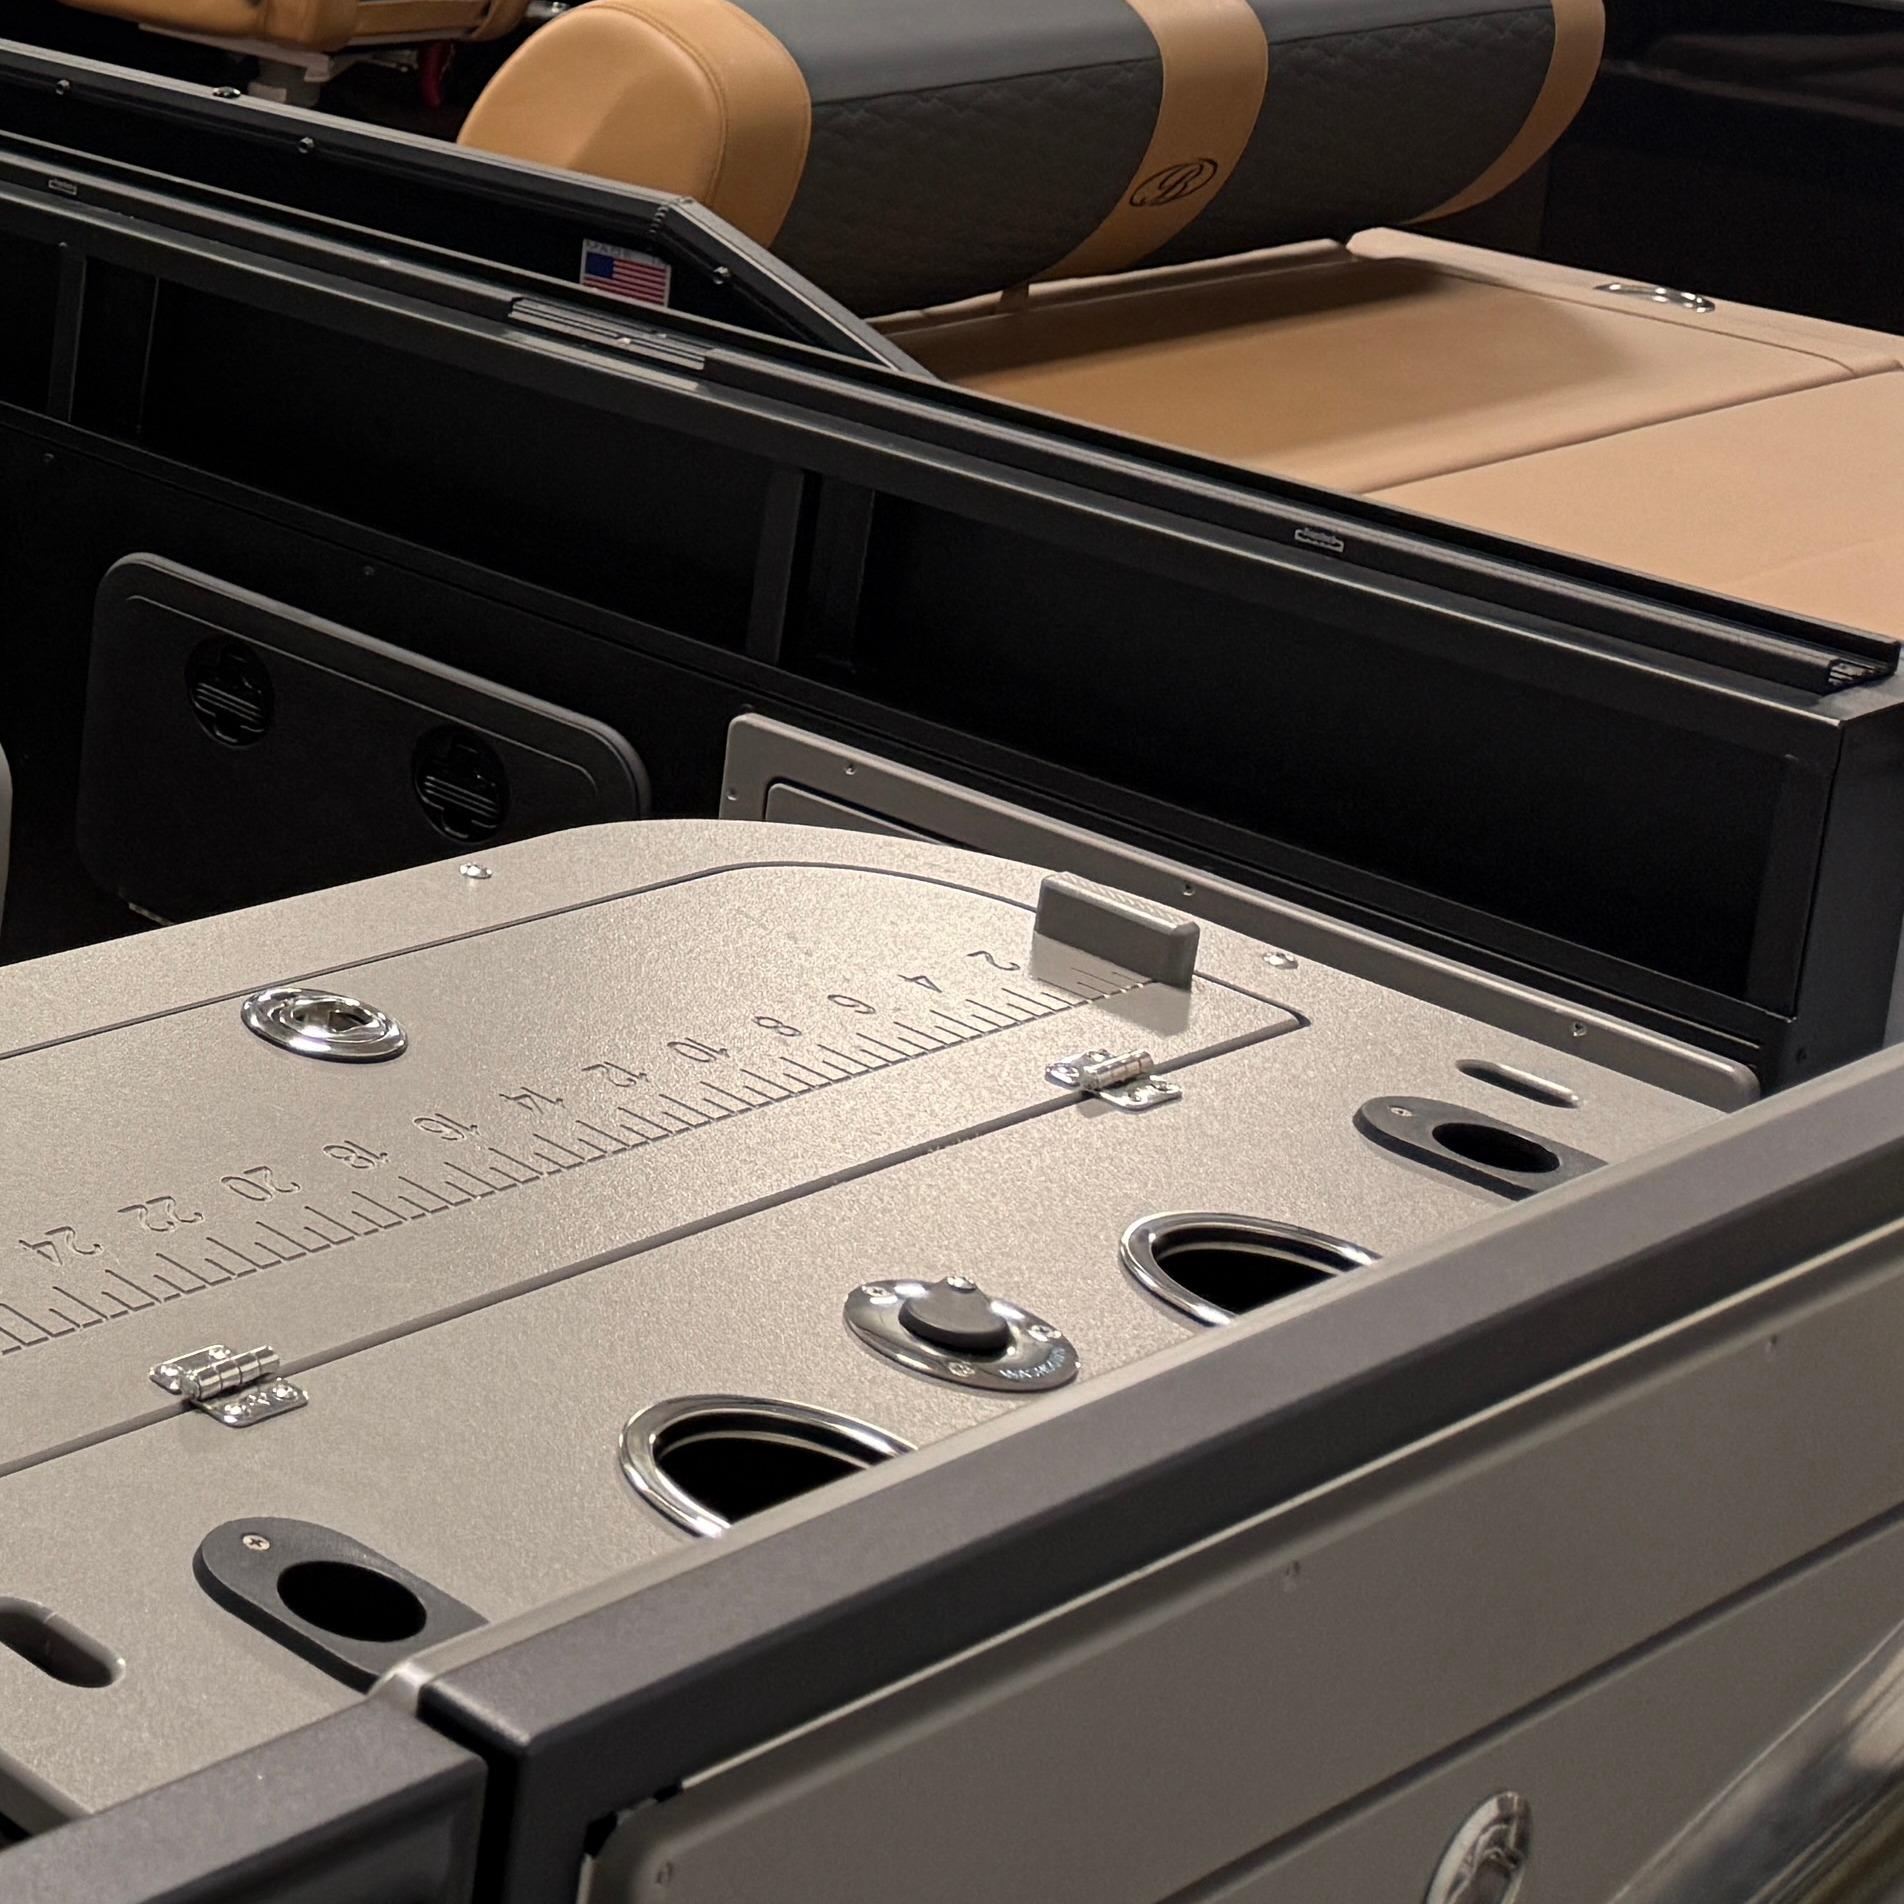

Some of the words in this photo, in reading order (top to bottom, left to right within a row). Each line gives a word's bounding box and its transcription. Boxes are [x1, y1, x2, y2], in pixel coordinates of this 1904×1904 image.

[18, 1225, 104, 1266] 24
[116, 1196, 204, 1233] 22
[221, 1165, 301, 1201] 20
[322, 1139, 388, 1169] 18
[413, 1112, 480, 1141] 16
[498, 1086, 565, 1116] 14
[581, 1060, 649, 1088] 12
[667, 1037, 729, 1064] 10
[752, 1015, 802, 1037] 8
[826, 993, 877, 1015] 6
[896, 973, 943, 994] 4
[966, 949, 1021, 972] 2
